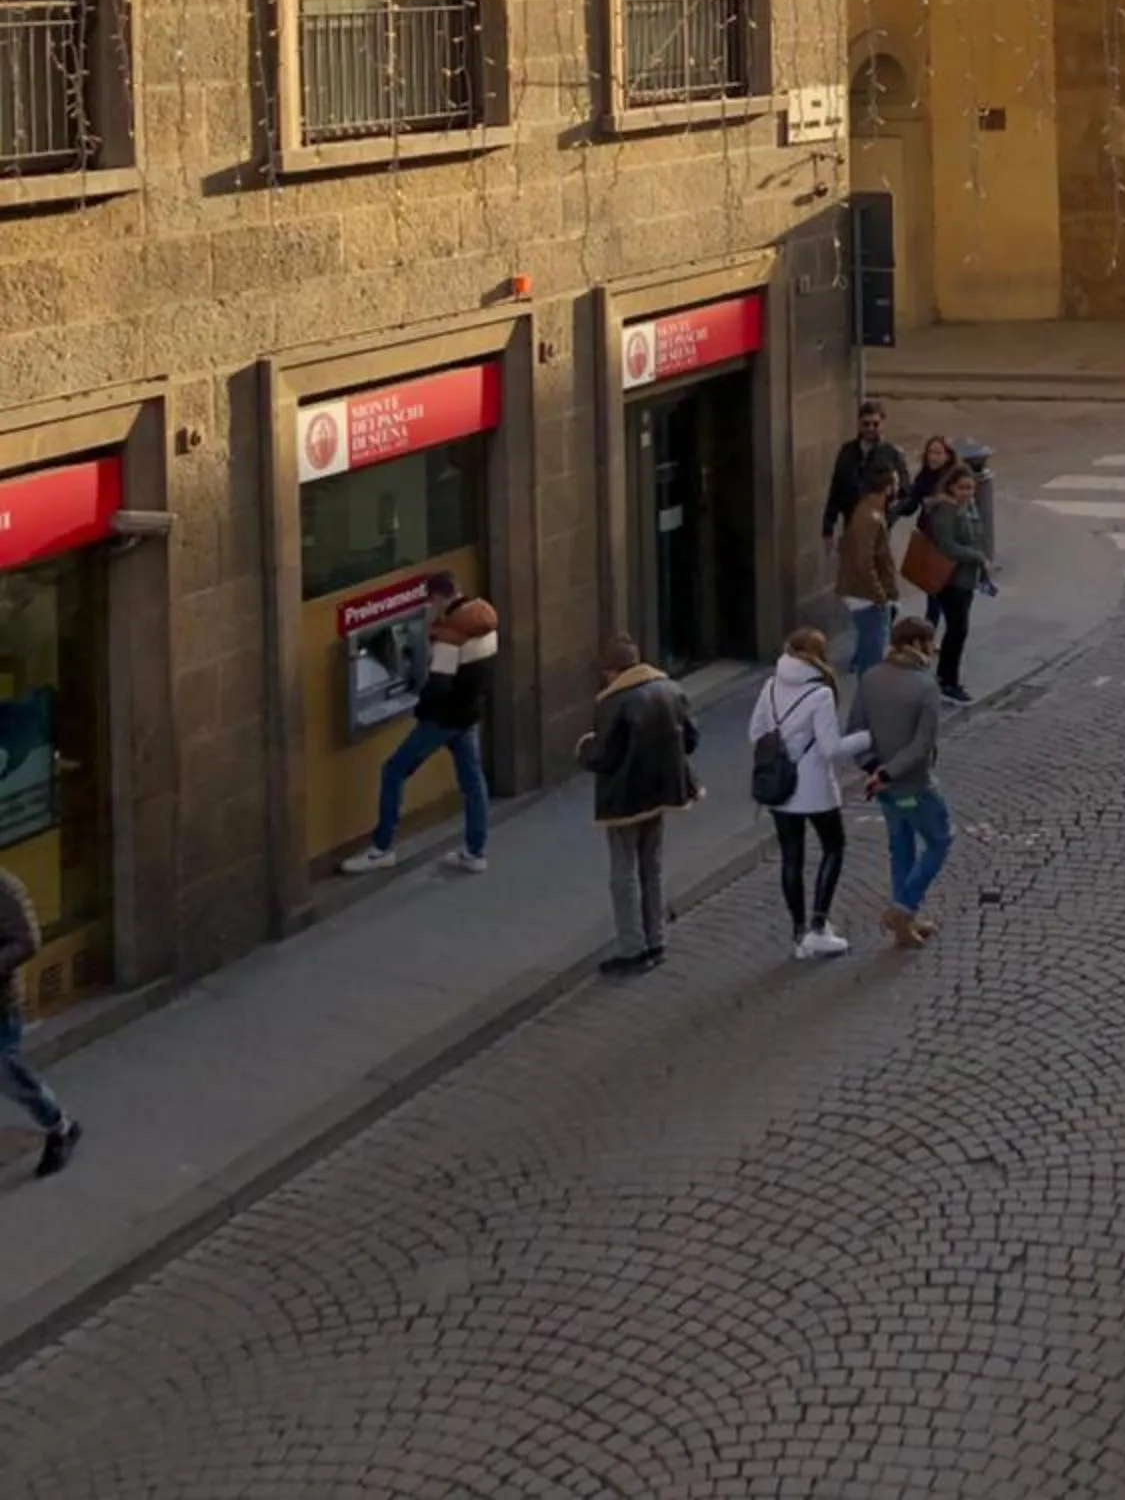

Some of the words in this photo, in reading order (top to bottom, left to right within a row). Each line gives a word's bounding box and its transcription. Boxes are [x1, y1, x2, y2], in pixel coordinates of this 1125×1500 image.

[352, 395, 399, 417] MONTE
[352, 417, 375, 436] DEI
[377, 403, 425, 426] PASCHI
